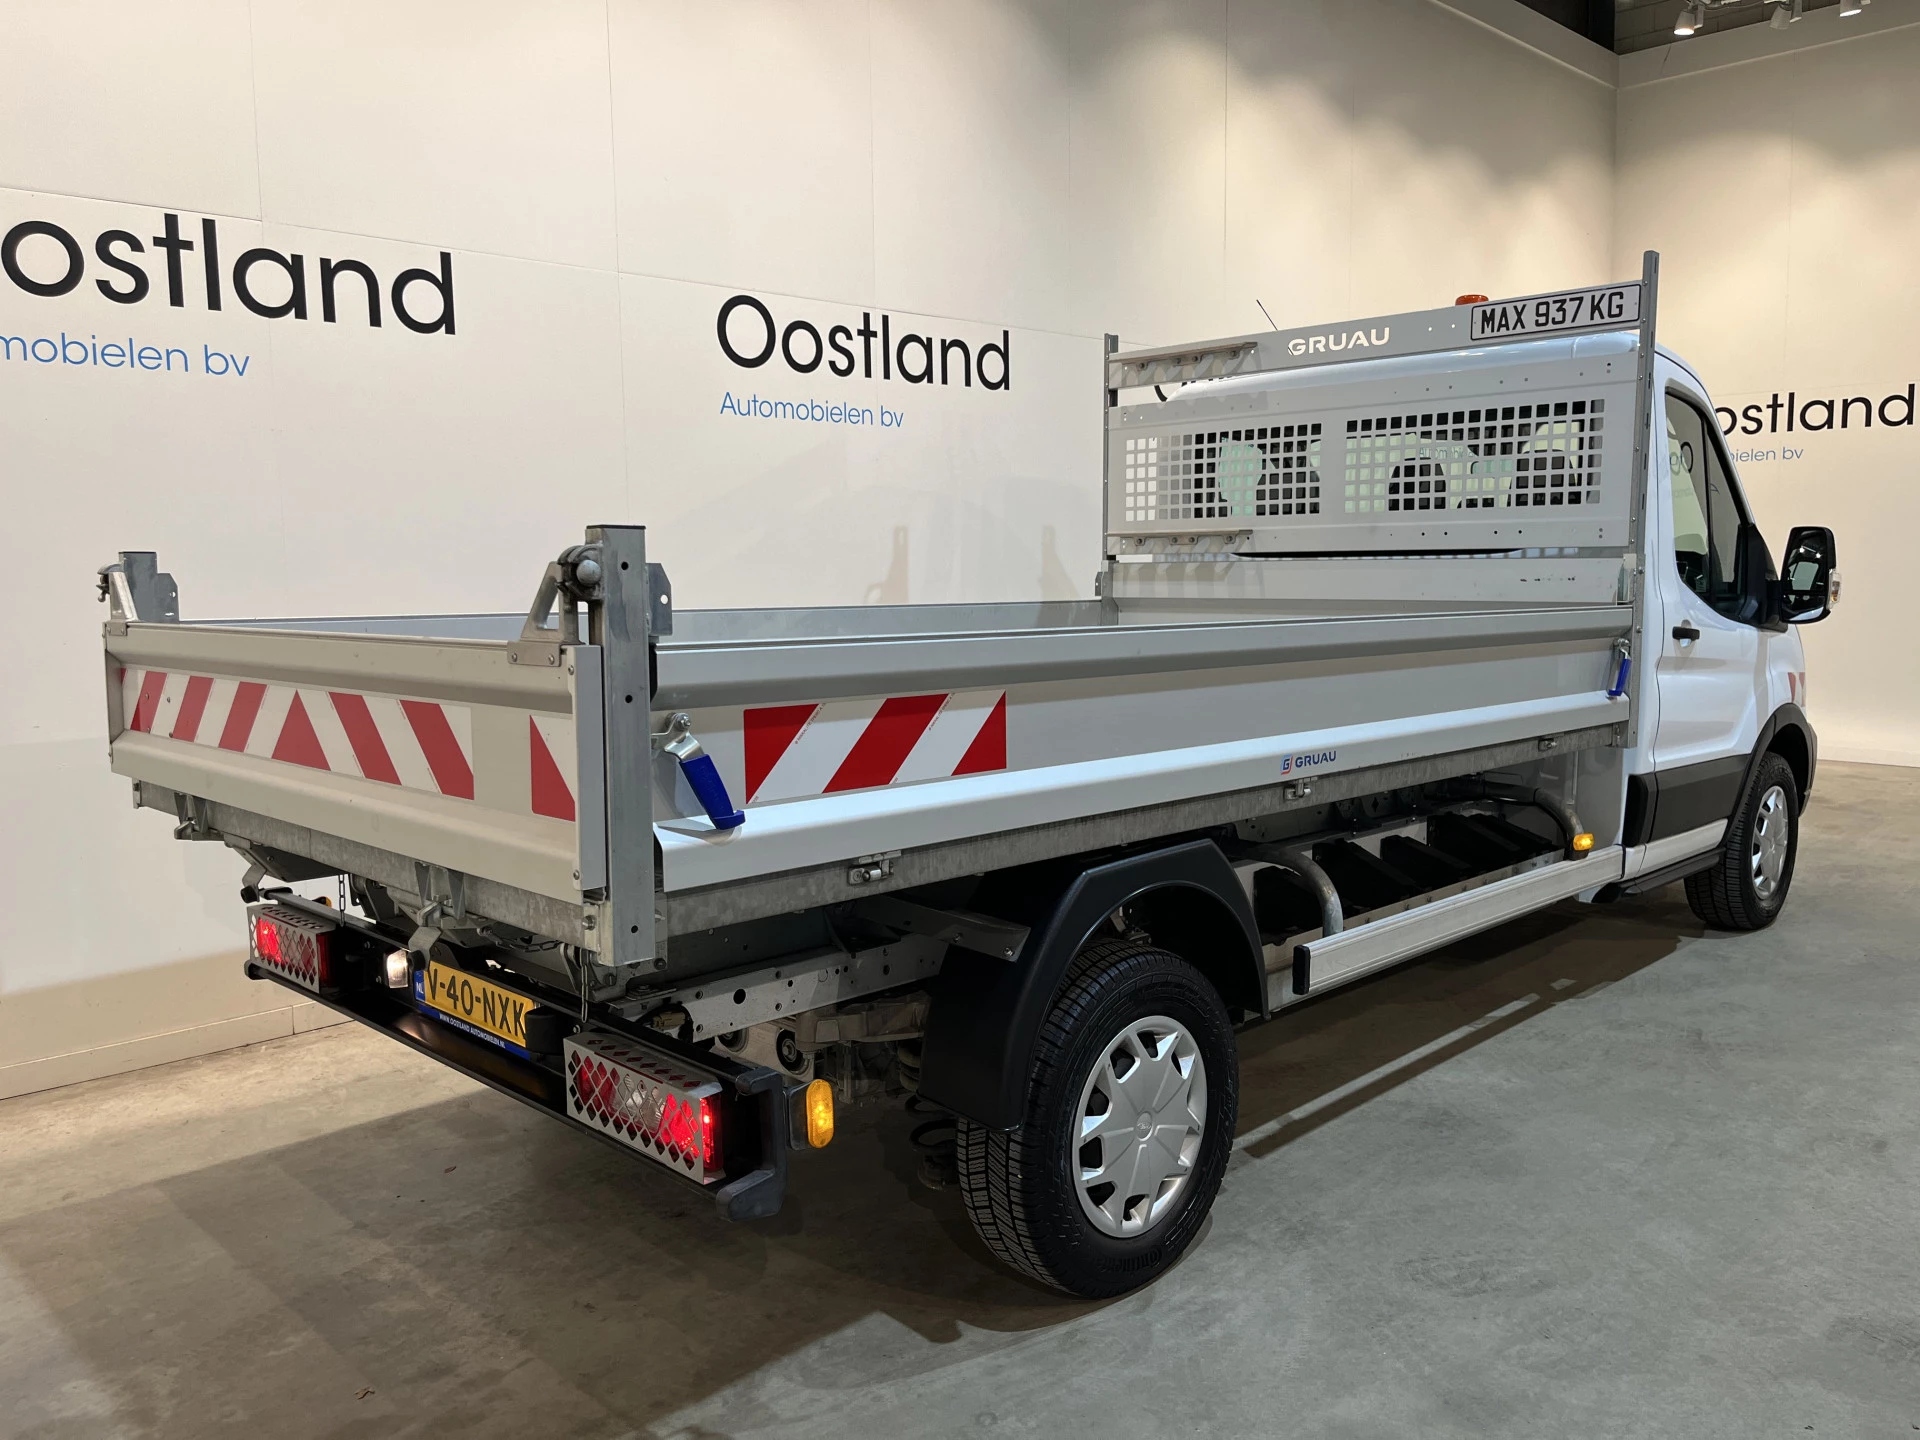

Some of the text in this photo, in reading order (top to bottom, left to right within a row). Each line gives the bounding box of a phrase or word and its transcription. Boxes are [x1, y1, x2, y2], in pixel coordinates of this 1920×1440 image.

[1481, 291, 1624, 334] MAX 937 KG
[716, 294, 1010, 391] Oostland
[1288, 327, 1390, 356] GRUAU
[205, 344, 250, 377] bv
[720, 391, 904, 428] Automobielen bv
[1782, 446, 1804, 460] bv
[1295, 750, 1337, 768] GRUAU
[416, 981, 424, 994] NL
[428, 968, 526, 1040] V-40-NXK
